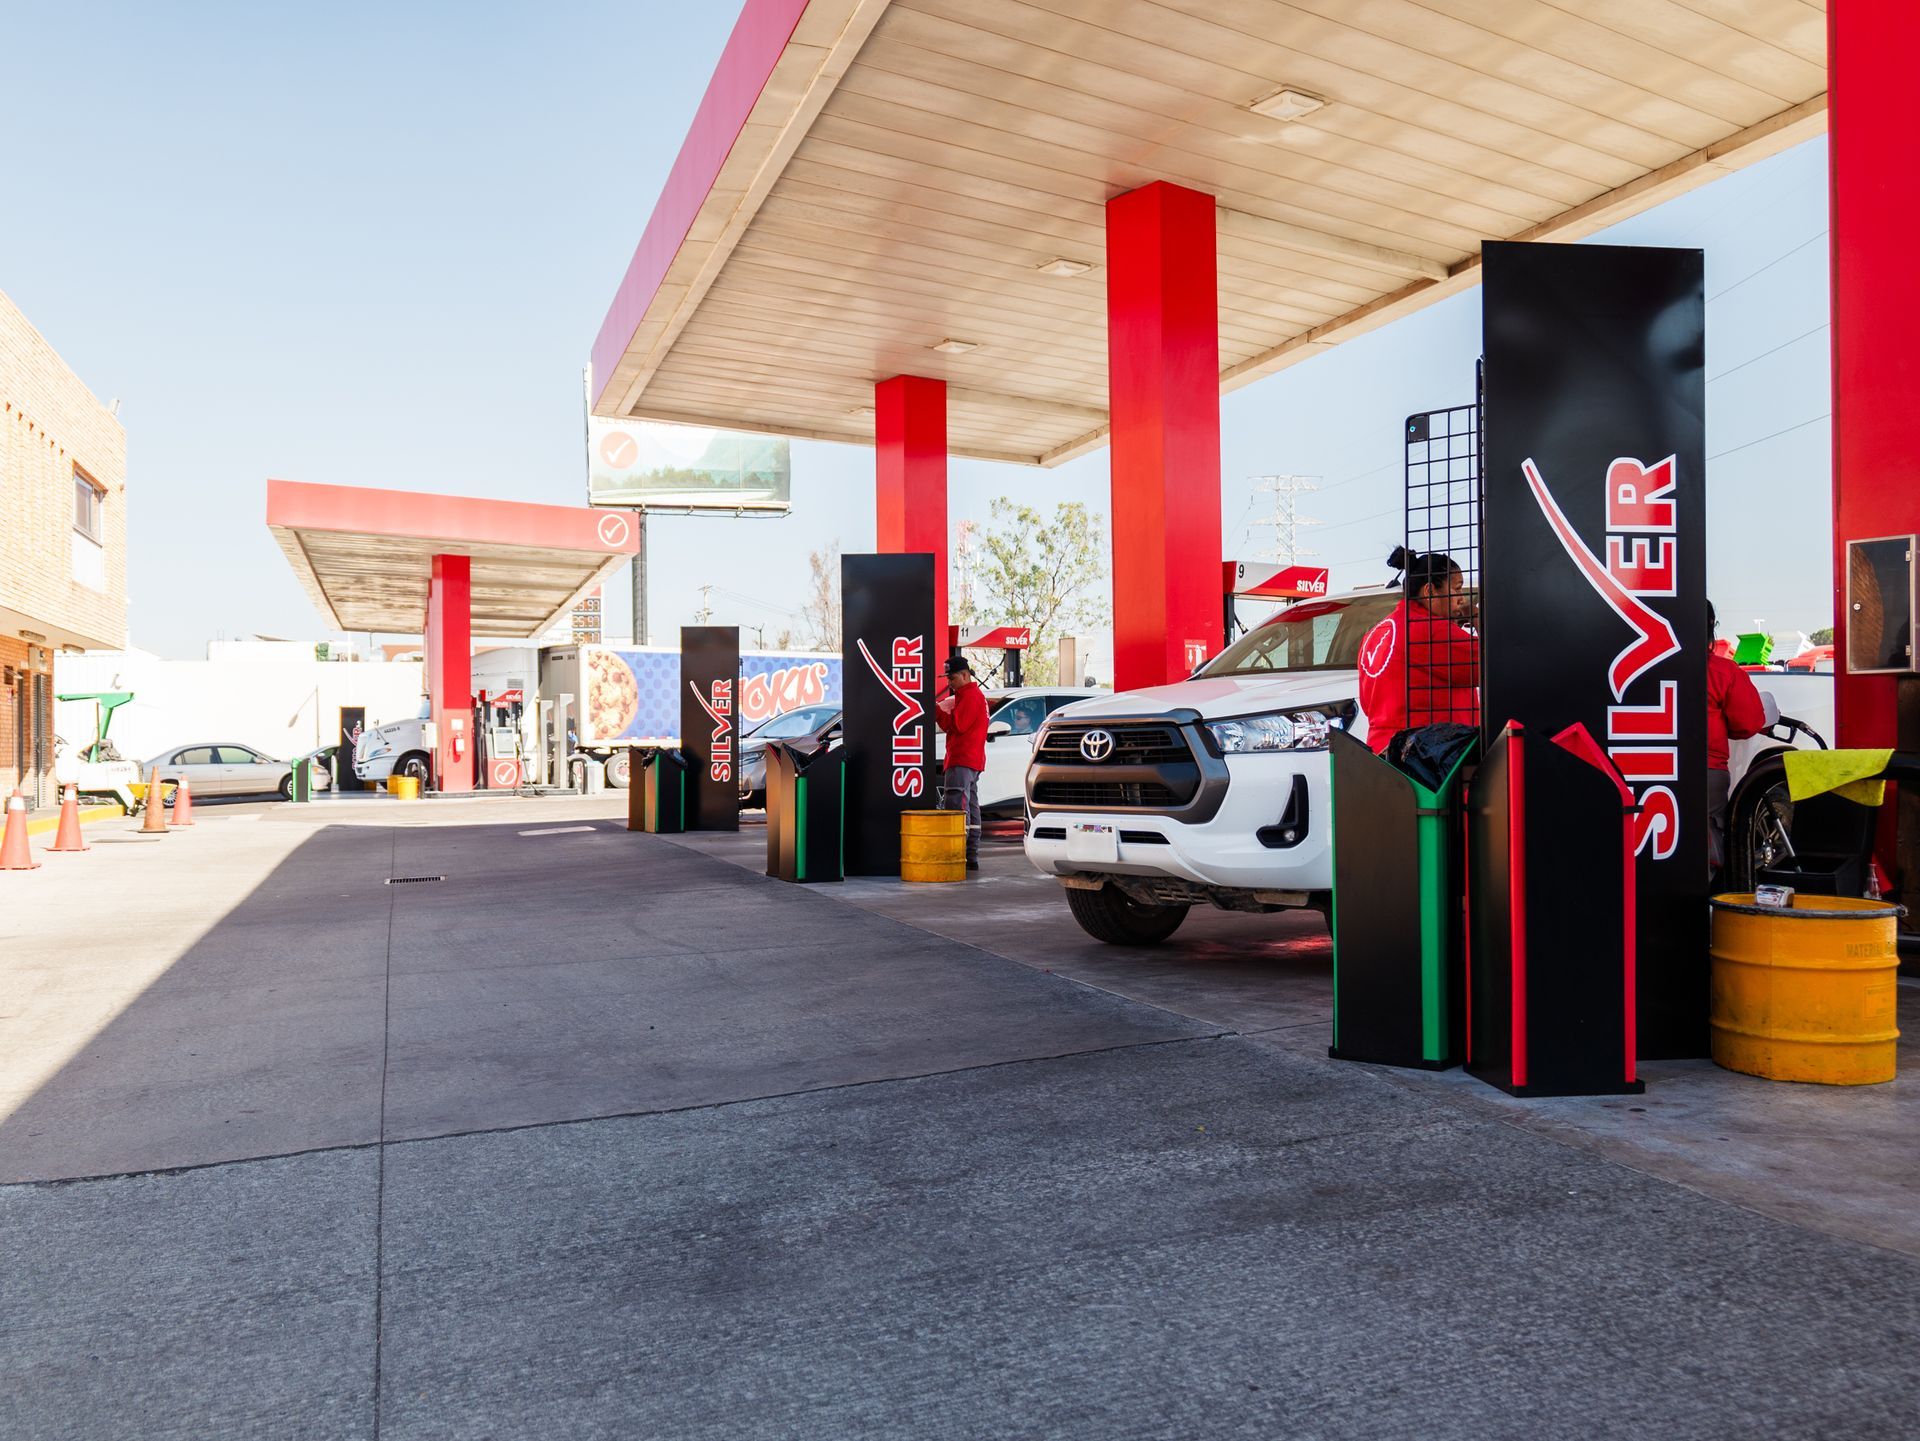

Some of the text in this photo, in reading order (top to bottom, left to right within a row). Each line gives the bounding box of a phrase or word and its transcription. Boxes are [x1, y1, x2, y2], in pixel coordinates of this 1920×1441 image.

[1238, 564, 1245, 579] 9
[1296, 569, 1327, 593] SILVER
[960, 627, 969, 638] 11
[1005, 629, 1029, 646] SILVER
[1520, 453, 1682, 861] SILVER
[857, 634, 925, 797] SILVER
[689, 678, 732, 783] SILVER
